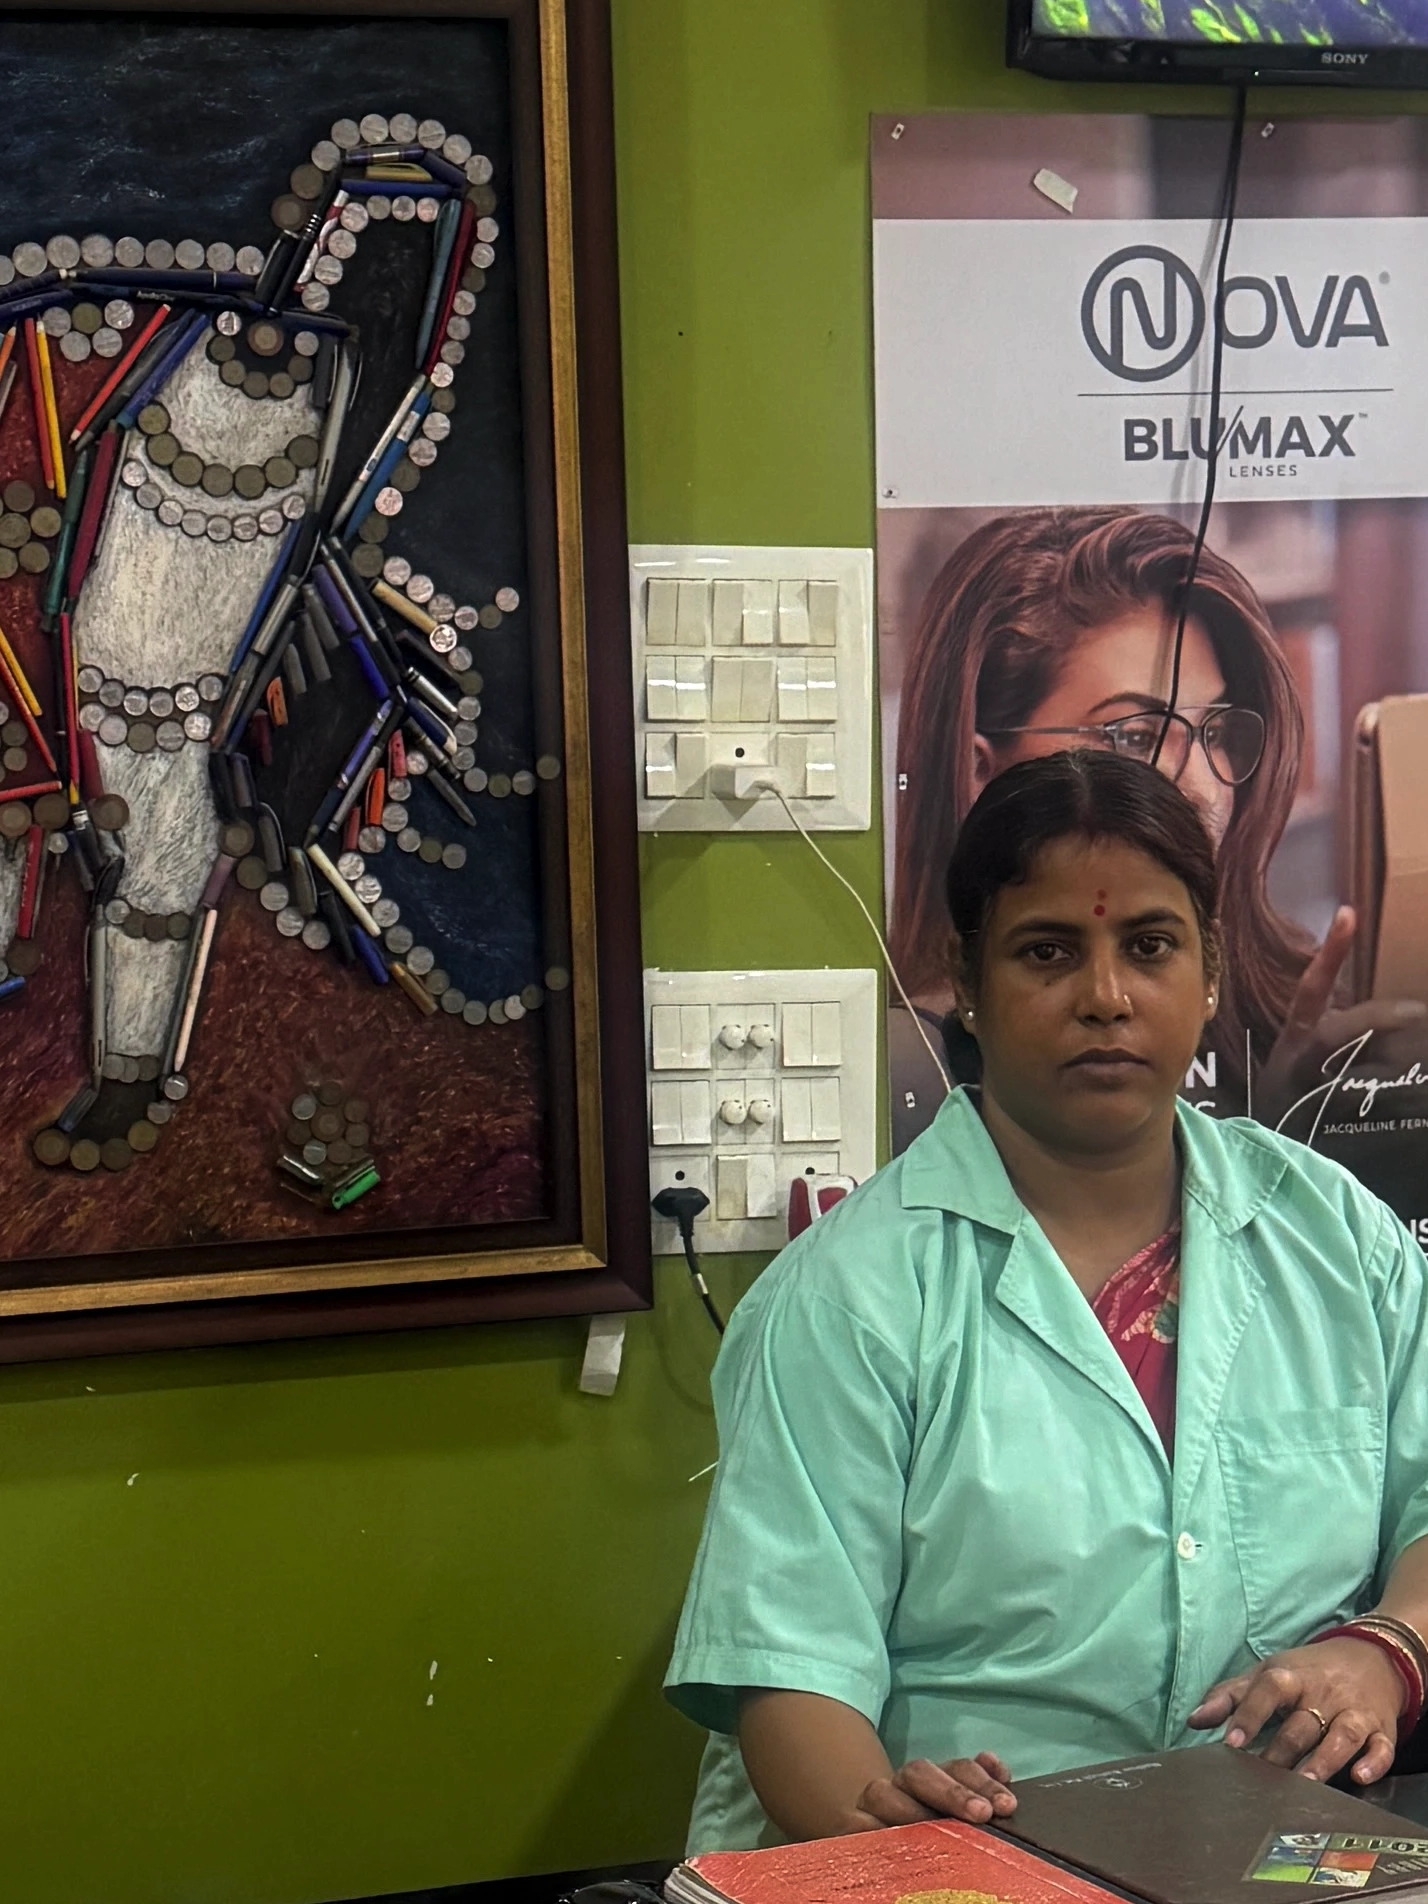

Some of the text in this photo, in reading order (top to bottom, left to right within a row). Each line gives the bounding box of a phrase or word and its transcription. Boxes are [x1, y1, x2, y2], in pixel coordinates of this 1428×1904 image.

[1321, 51, 1370, 65] SONY
[1081, 245, 1390, 383] NOVA
[1124, 414, 1357, 461] BLUMAX
[1229, 464, 1299, 478] LENSES
[1323, 1120, 1397, 1135] JACQUELINE
